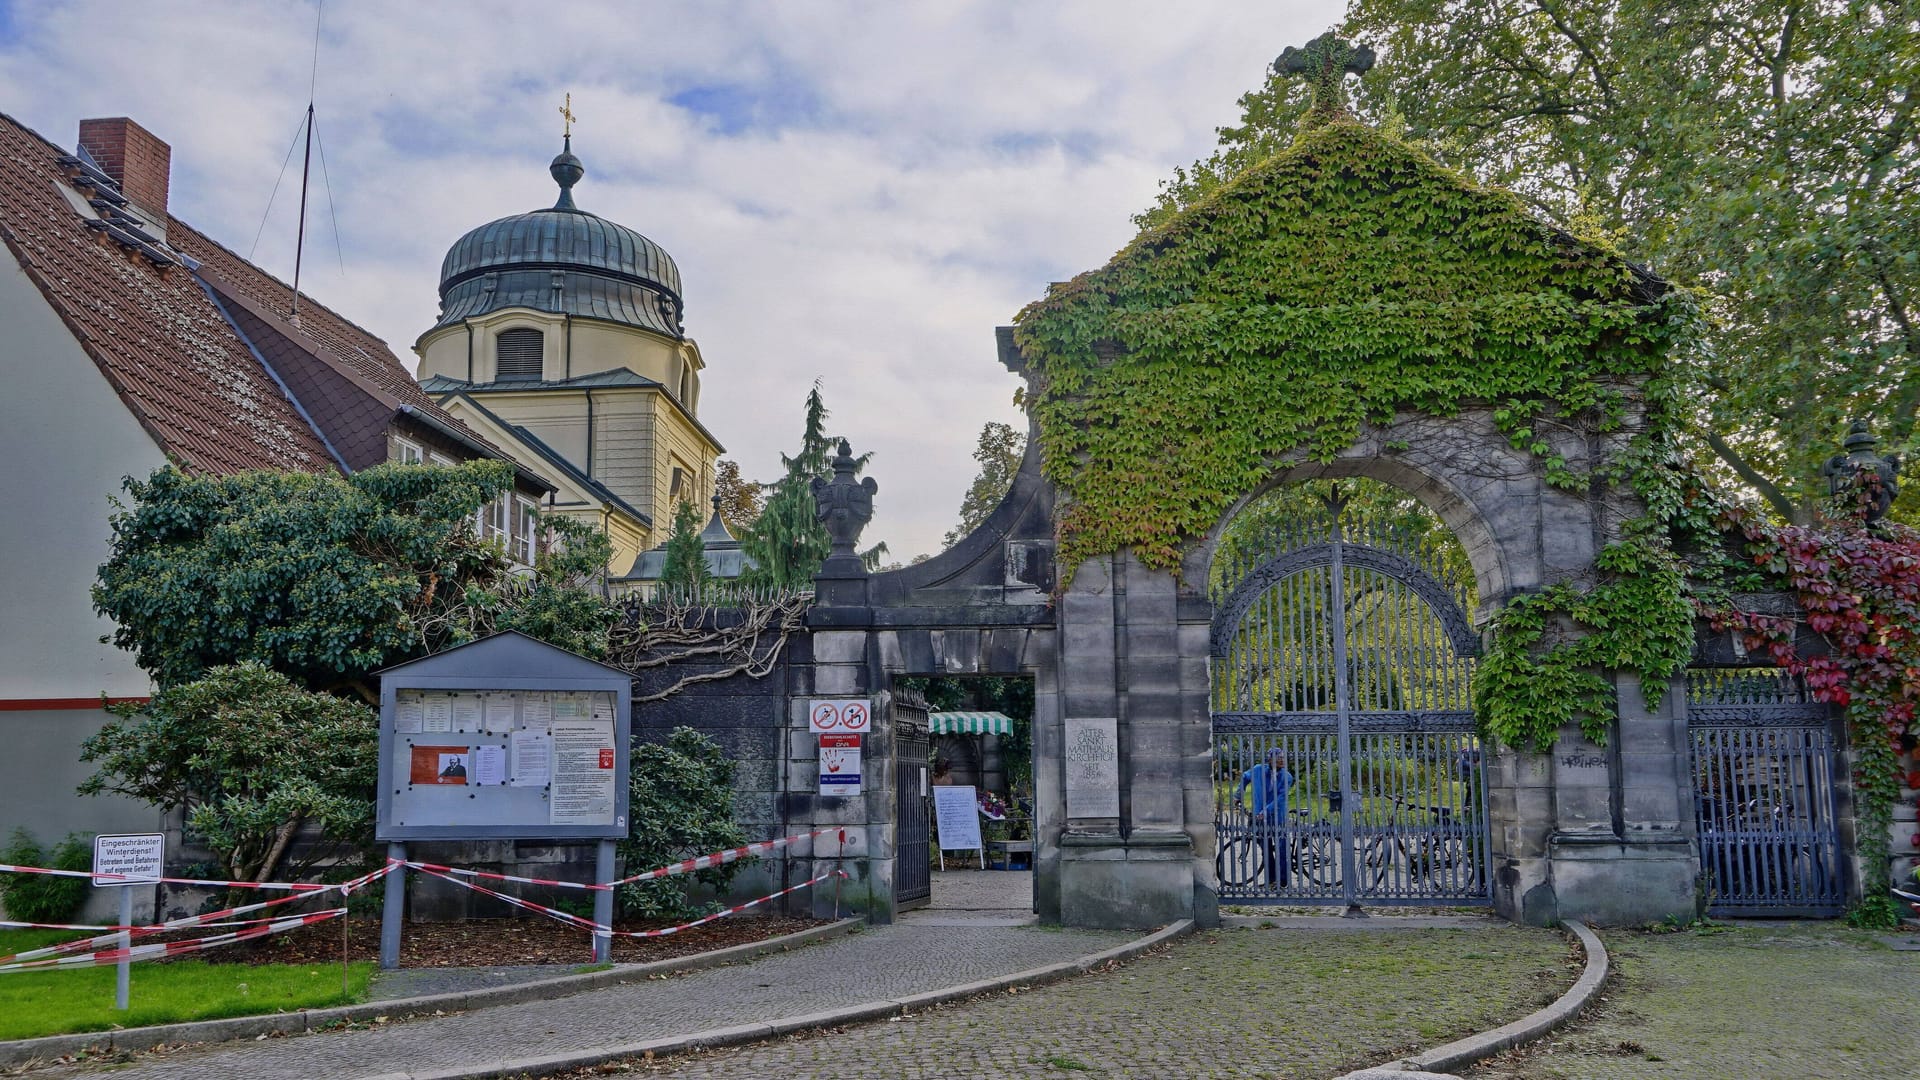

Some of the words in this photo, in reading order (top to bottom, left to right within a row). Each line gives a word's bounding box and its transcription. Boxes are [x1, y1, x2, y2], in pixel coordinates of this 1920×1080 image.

[1079, 728, 1105, 737] ALTER
[1077, 736, 1107, 745] SANKT
[1067, 753, 1113, 762] KIRCHHOF
[1084, 762, 1100, 771] SEIT
[101, 839, 160, 848] Eingeschränkter
[106, 848, 154, 856] Winterdienst!
[100, 858, 123, 866] Betreten
[135, 856, 159, 864] Befahren
